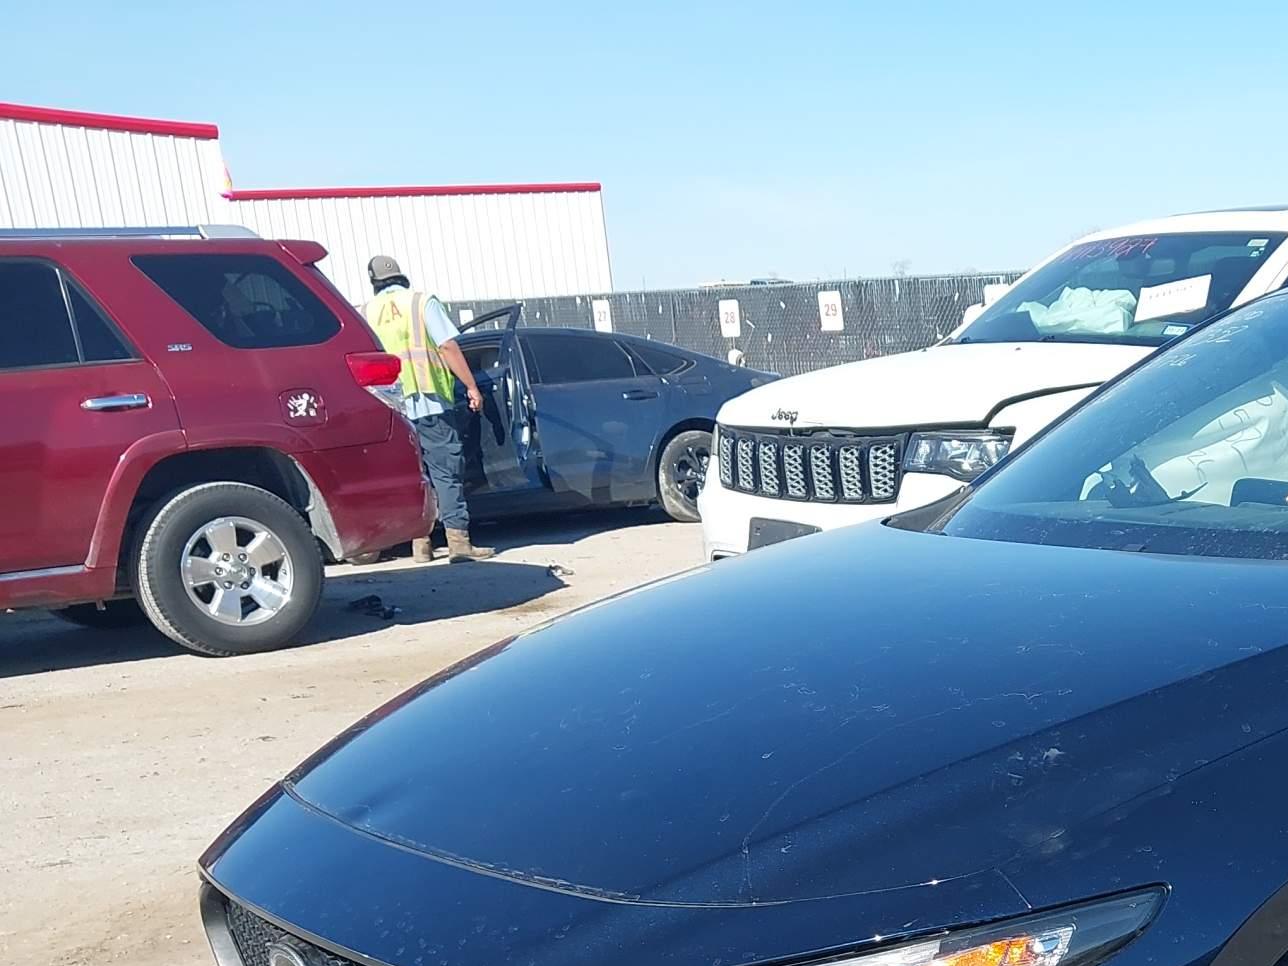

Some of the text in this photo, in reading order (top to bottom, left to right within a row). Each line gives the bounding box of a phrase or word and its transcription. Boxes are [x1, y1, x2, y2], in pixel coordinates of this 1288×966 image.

[597, 310, 607, 322] 27
[824, 303, 838, 317] 29
[724, 311, 736, 324] 28
